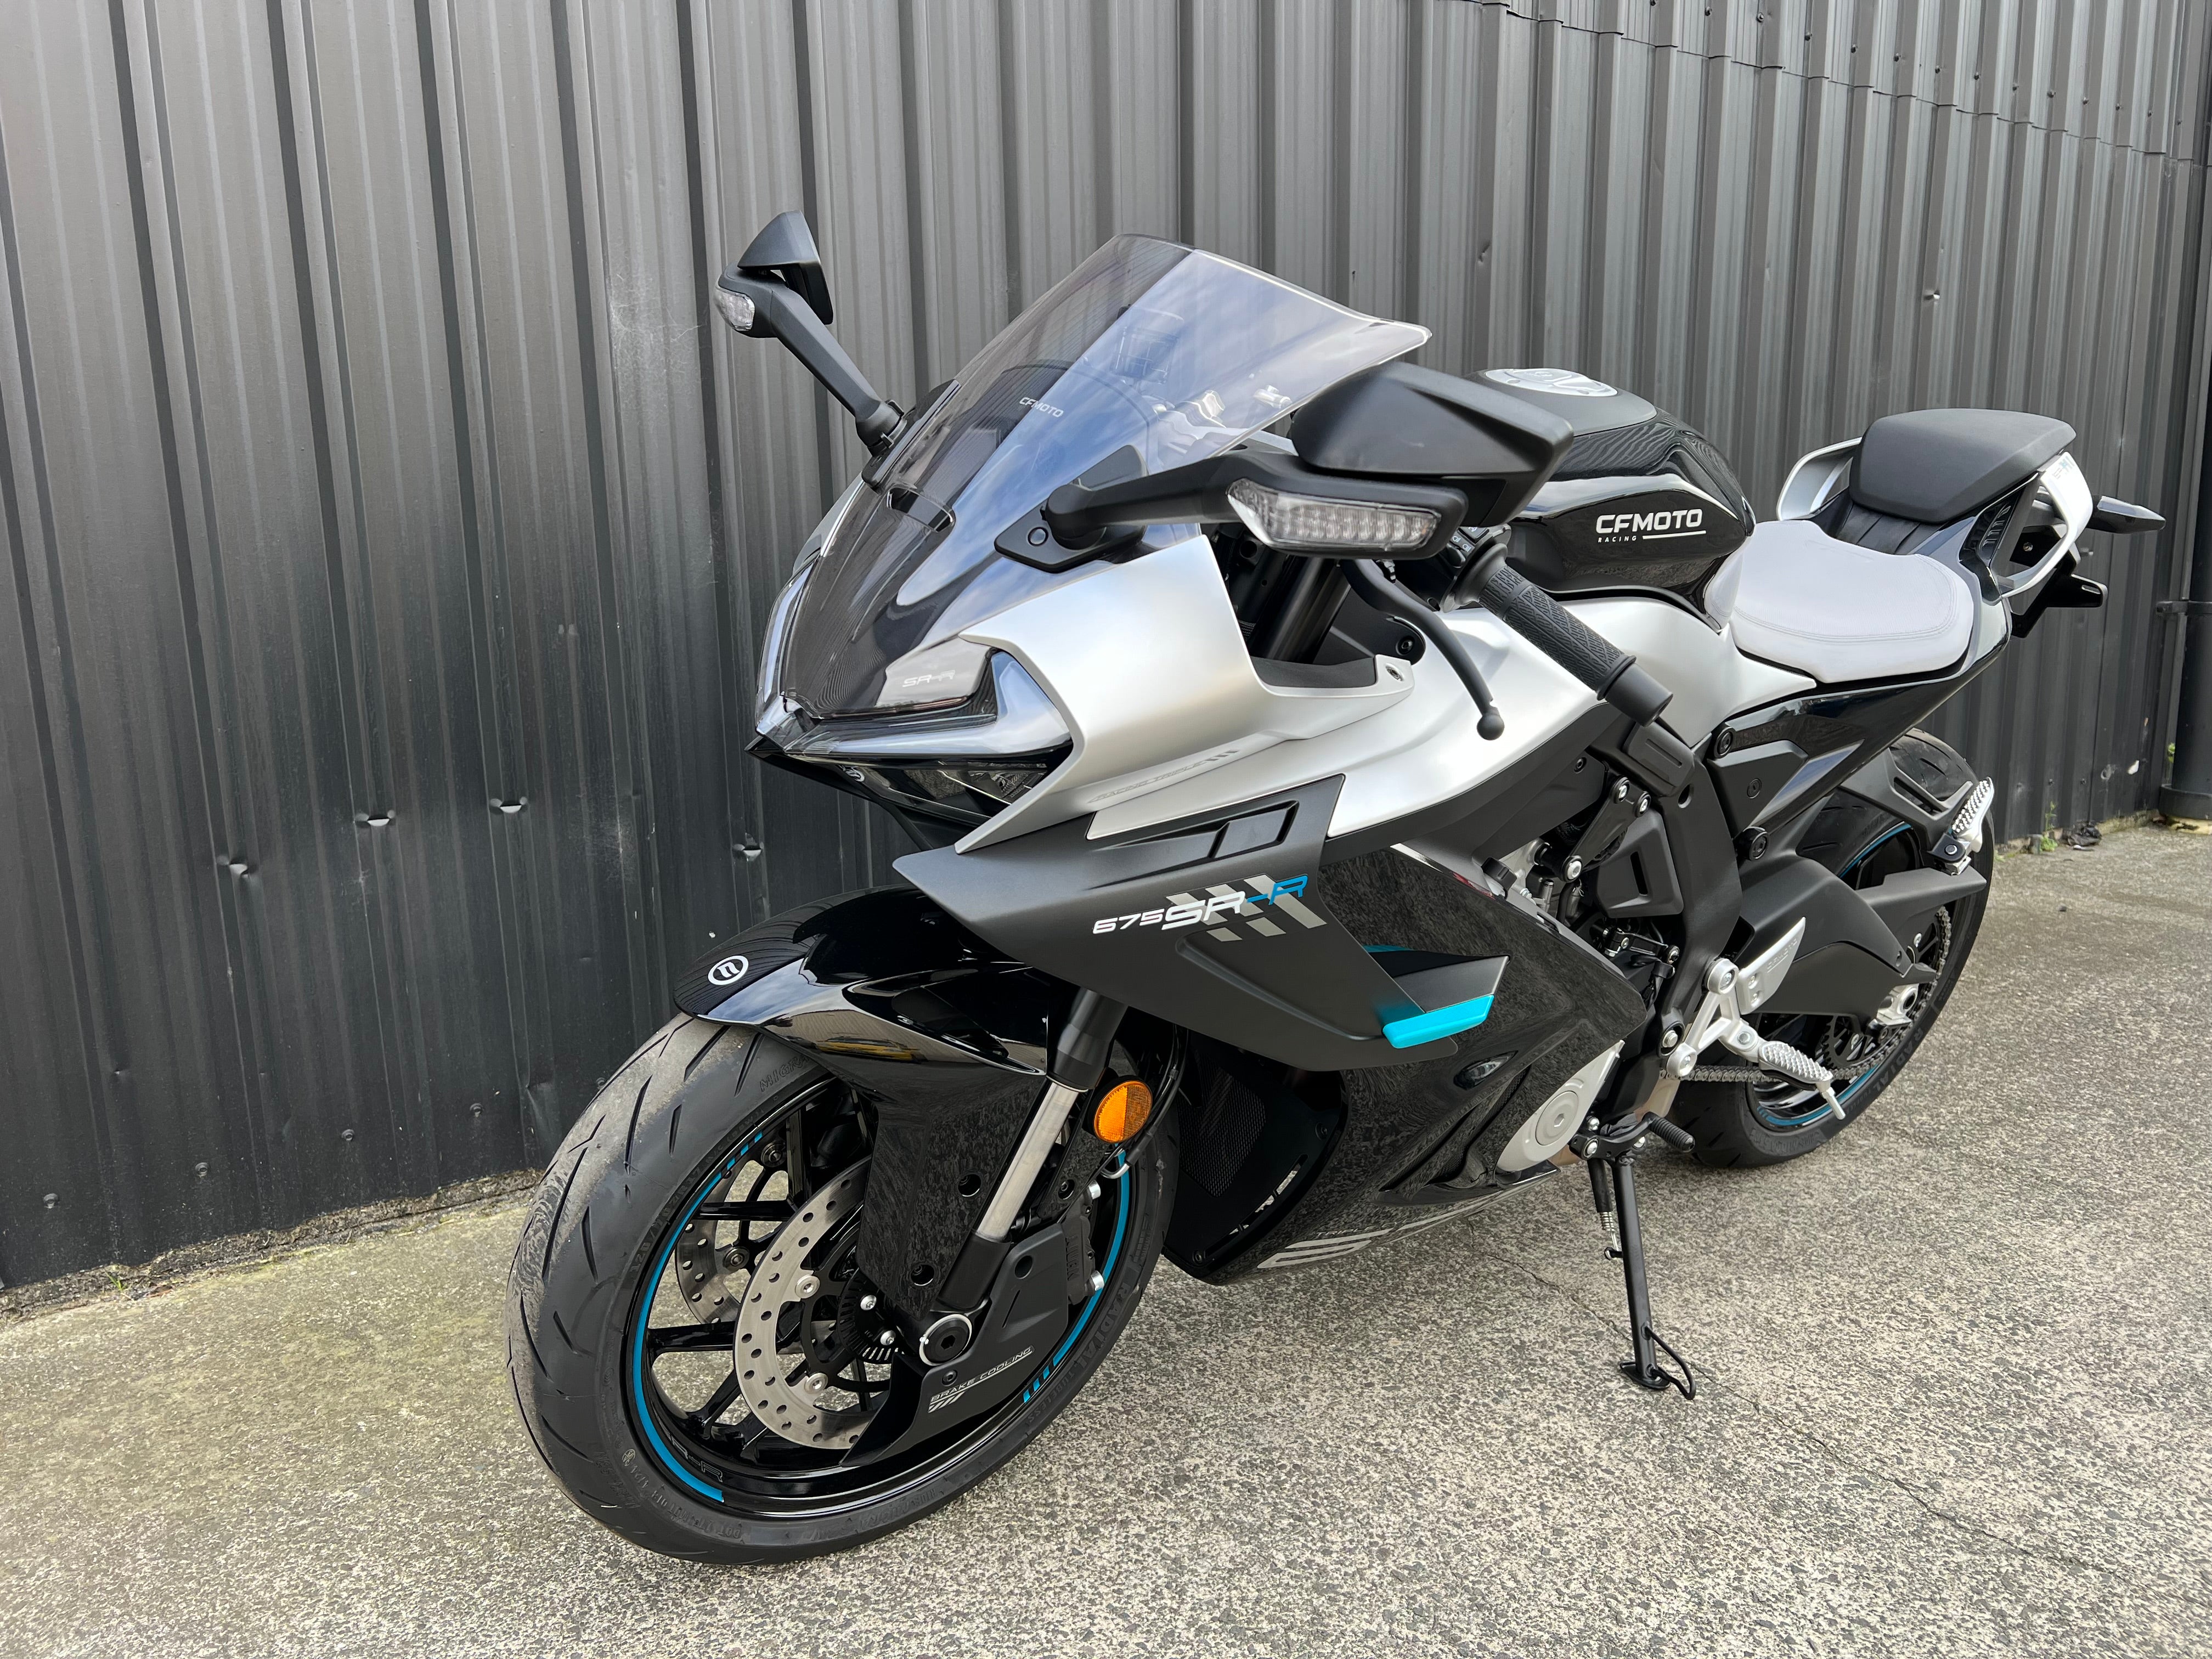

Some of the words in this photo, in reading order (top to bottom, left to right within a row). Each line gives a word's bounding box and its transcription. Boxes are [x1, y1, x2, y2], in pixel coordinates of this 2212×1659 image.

[1019, 397, 1064, 417] CFMOTO
[1596, 509, 1703, 534] CFMOTO
[1077, 1282, 1133, 1369] RADIAL
[930, 1378, 975, 1402] BRAKE
[979, 1346, 1032, 1380] COOLING
